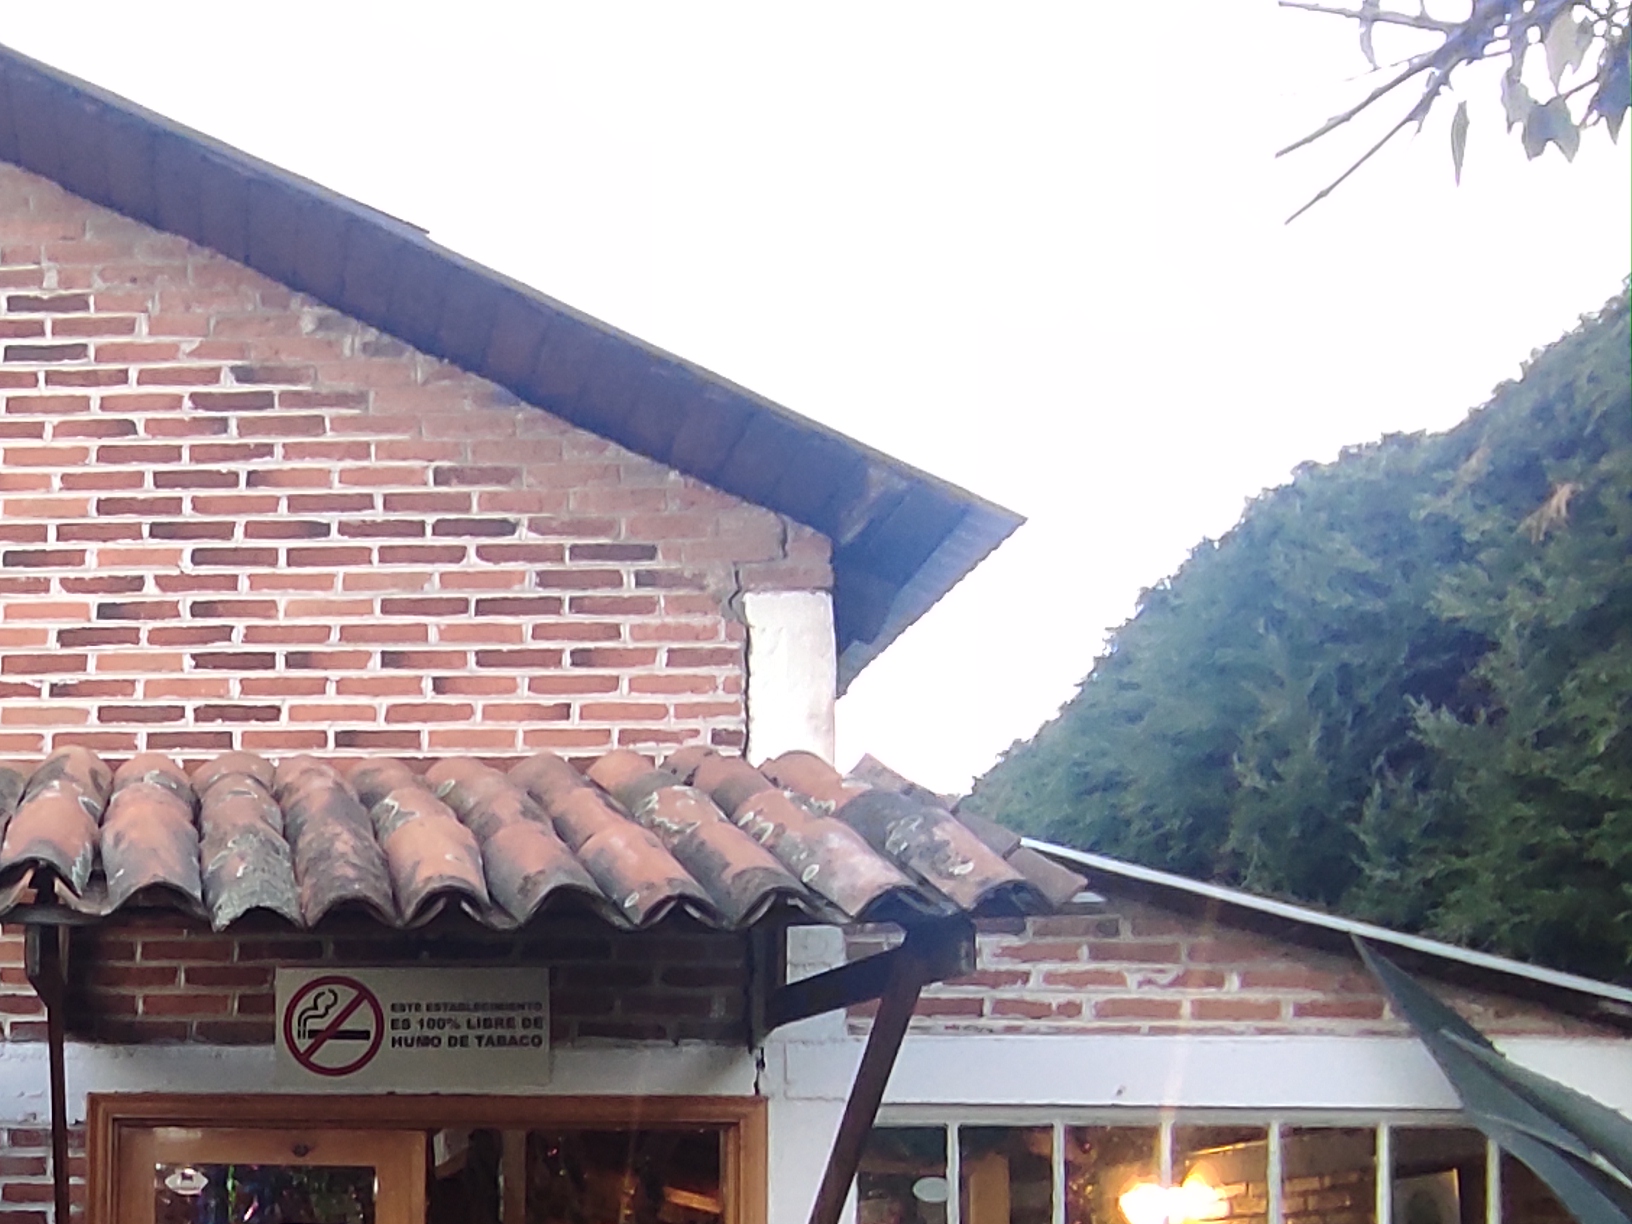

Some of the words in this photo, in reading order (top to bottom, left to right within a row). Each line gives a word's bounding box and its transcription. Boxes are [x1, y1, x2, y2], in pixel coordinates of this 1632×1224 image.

[390, 1002, 422, 1013] ESTE
[390, 1018, 411, 1030] ES
[418, 1017, 461, 1030] 100%
[466, 1016, 516, 1030] LIBRE
[521, 1016, 544, 1030] DE
[391, 1035, 442, 1048] HUMO
[447, 1035, 469, 1048] DE
[474, 1034, 543, 1048] TABACO
